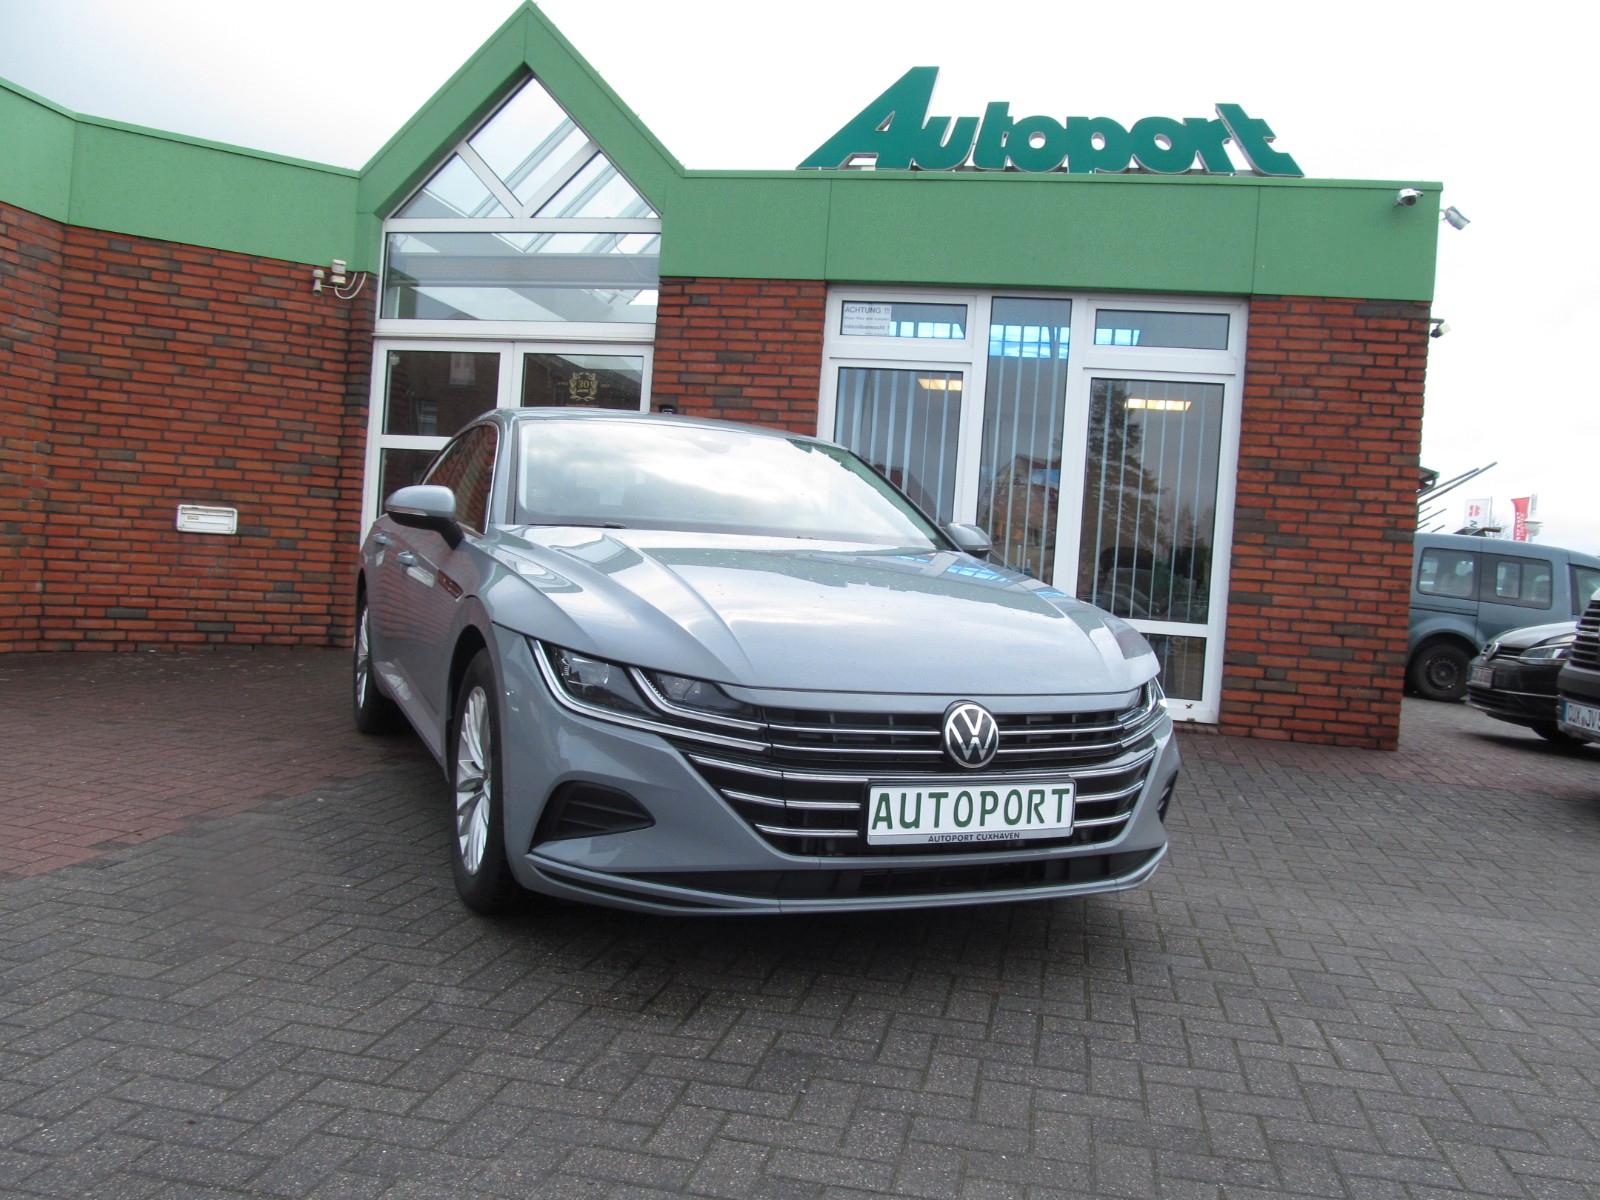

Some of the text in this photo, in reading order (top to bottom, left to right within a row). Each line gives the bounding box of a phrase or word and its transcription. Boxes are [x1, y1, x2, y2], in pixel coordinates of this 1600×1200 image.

[796, 66, 1305, 177] Autoport
[845, 305, 882, 314] ACHTUNG
[871, 788, 1070, 830] AUTOPORT
[928, 832, 1021, 843] AUTOPORT CUXHAVEN
